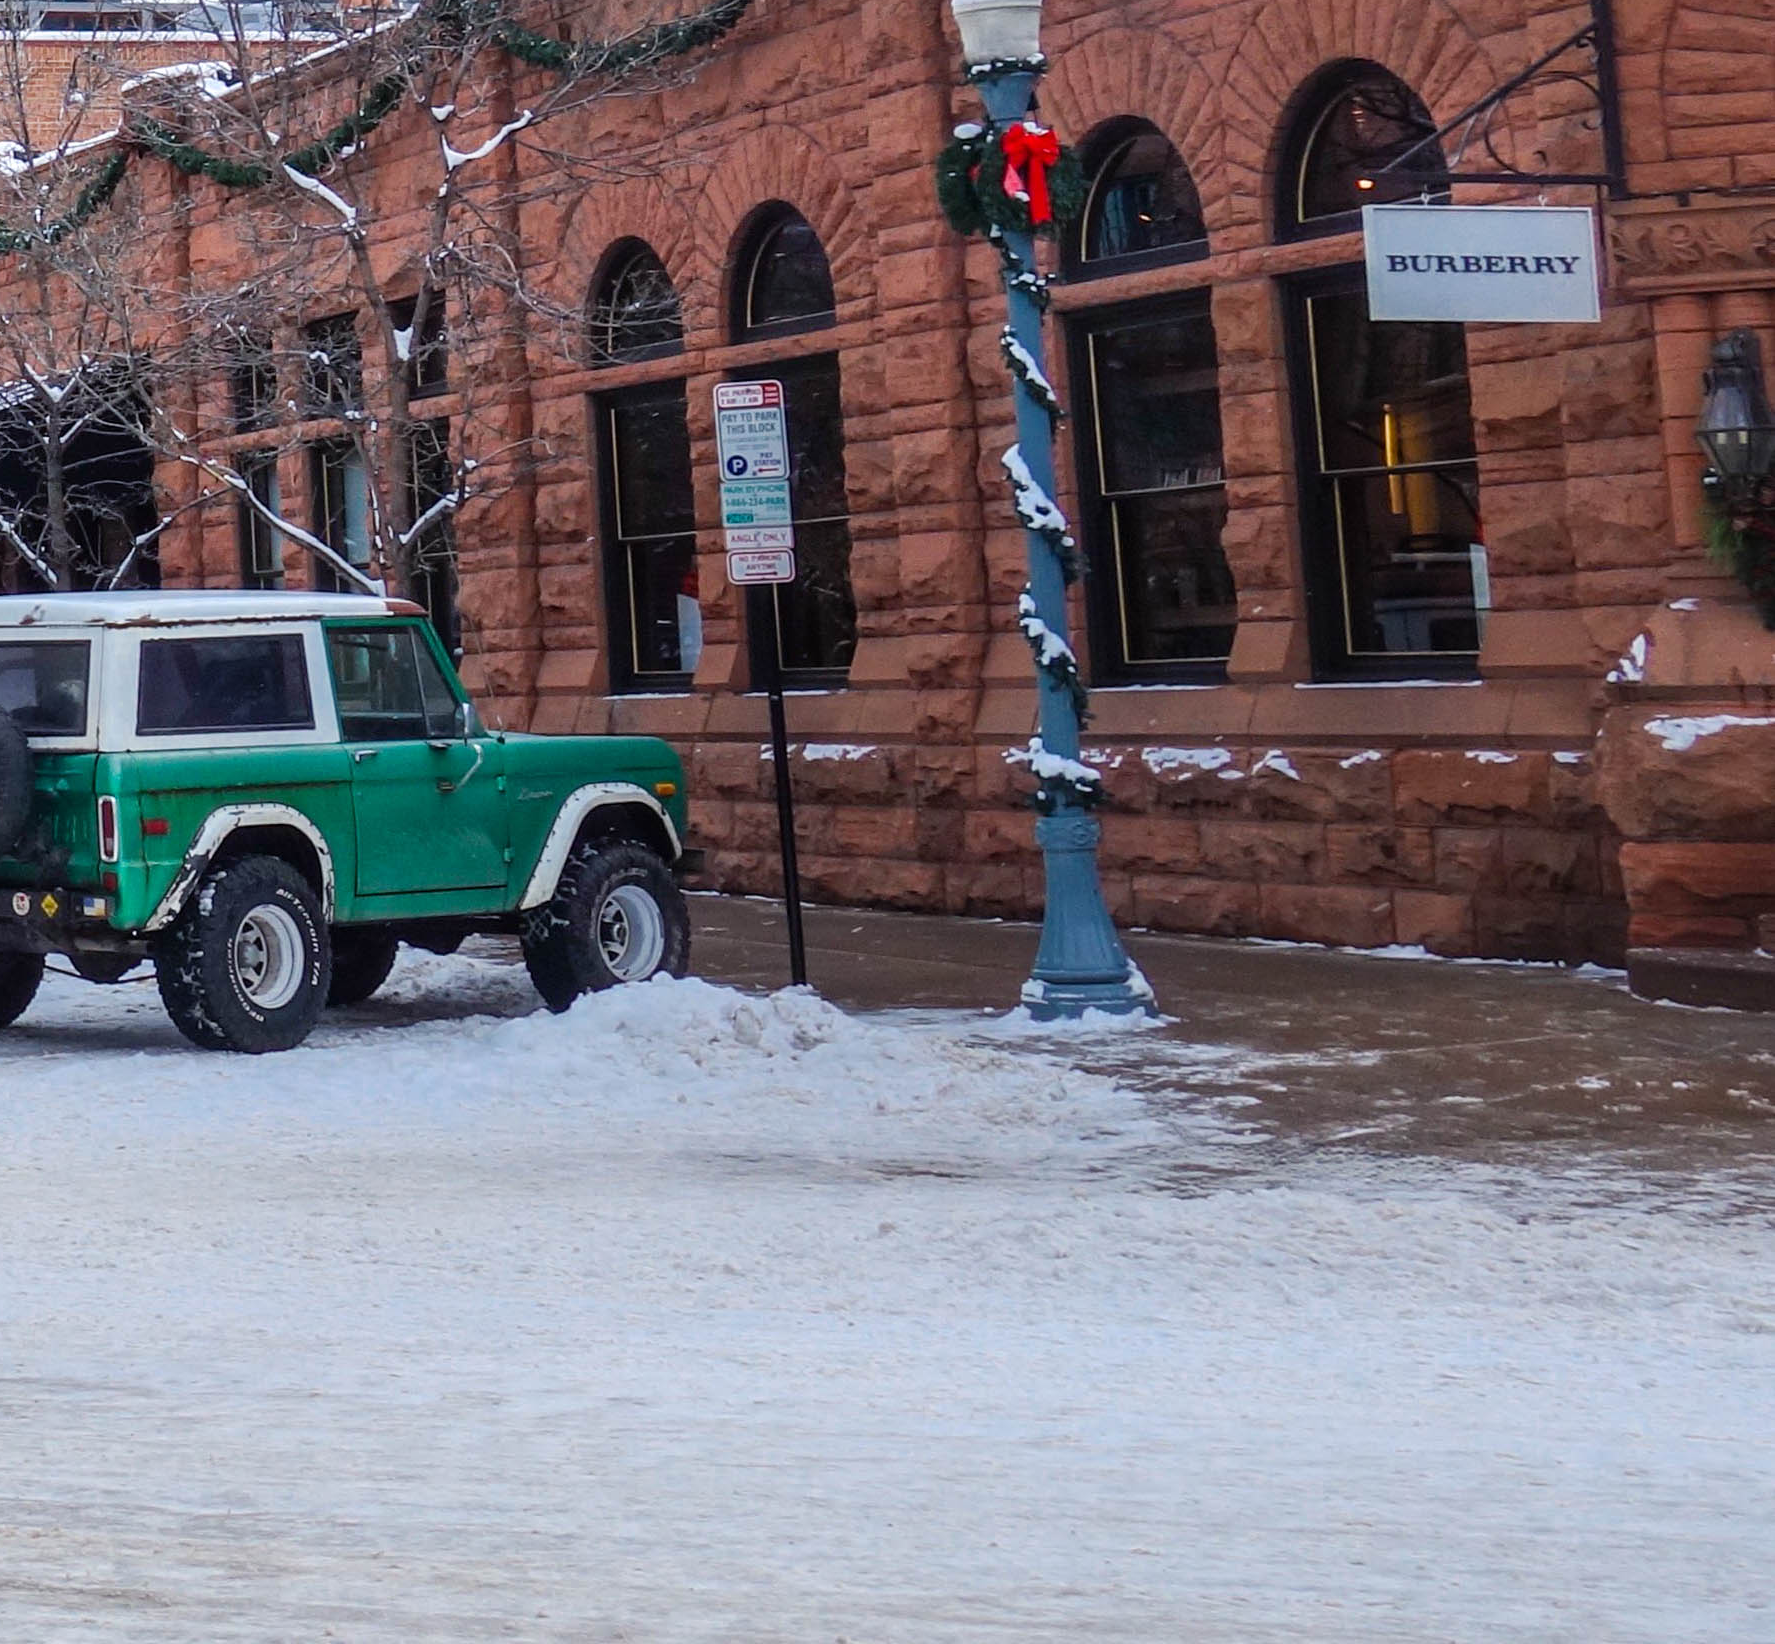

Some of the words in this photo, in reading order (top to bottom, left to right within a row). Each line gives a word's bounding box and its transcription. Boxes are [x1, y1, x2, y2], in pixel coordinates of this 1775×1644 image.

[1386, 254, 1581, 275] BURBERRY
[722, 414, 738, 423] PAY
[740, 412, 752, 422] TO
[755, 411, 779, 421] PARK
[726, 424, 746, 434] THIS
[748, 423, 776, 433] BLOCK
